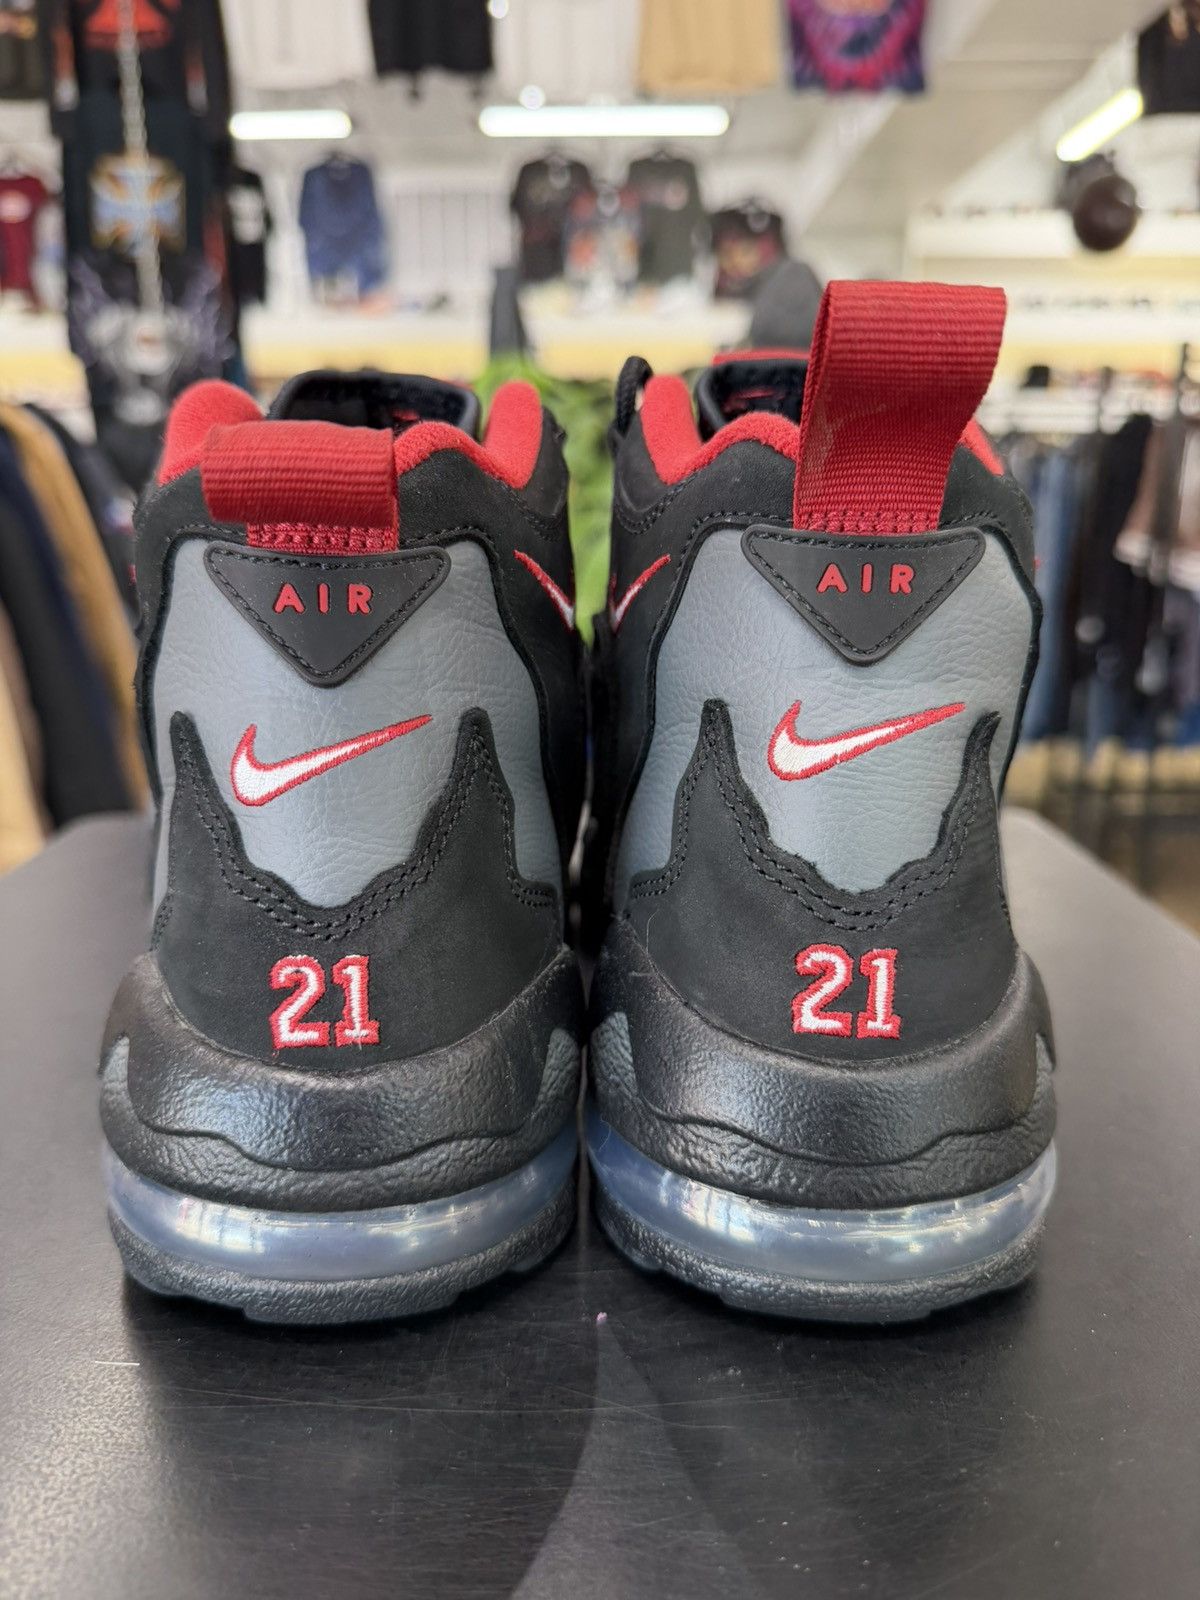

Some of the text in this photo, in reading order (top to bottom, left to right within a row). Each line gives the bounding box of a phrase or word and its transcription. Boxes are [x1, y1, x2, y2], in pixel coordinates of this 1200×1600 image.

[274, 582, 373, 614] AIR
[816, 564, 914, 594] AIR
[269, 954, 379, 1049] 21
[791, 943, 901, 1039] 21
